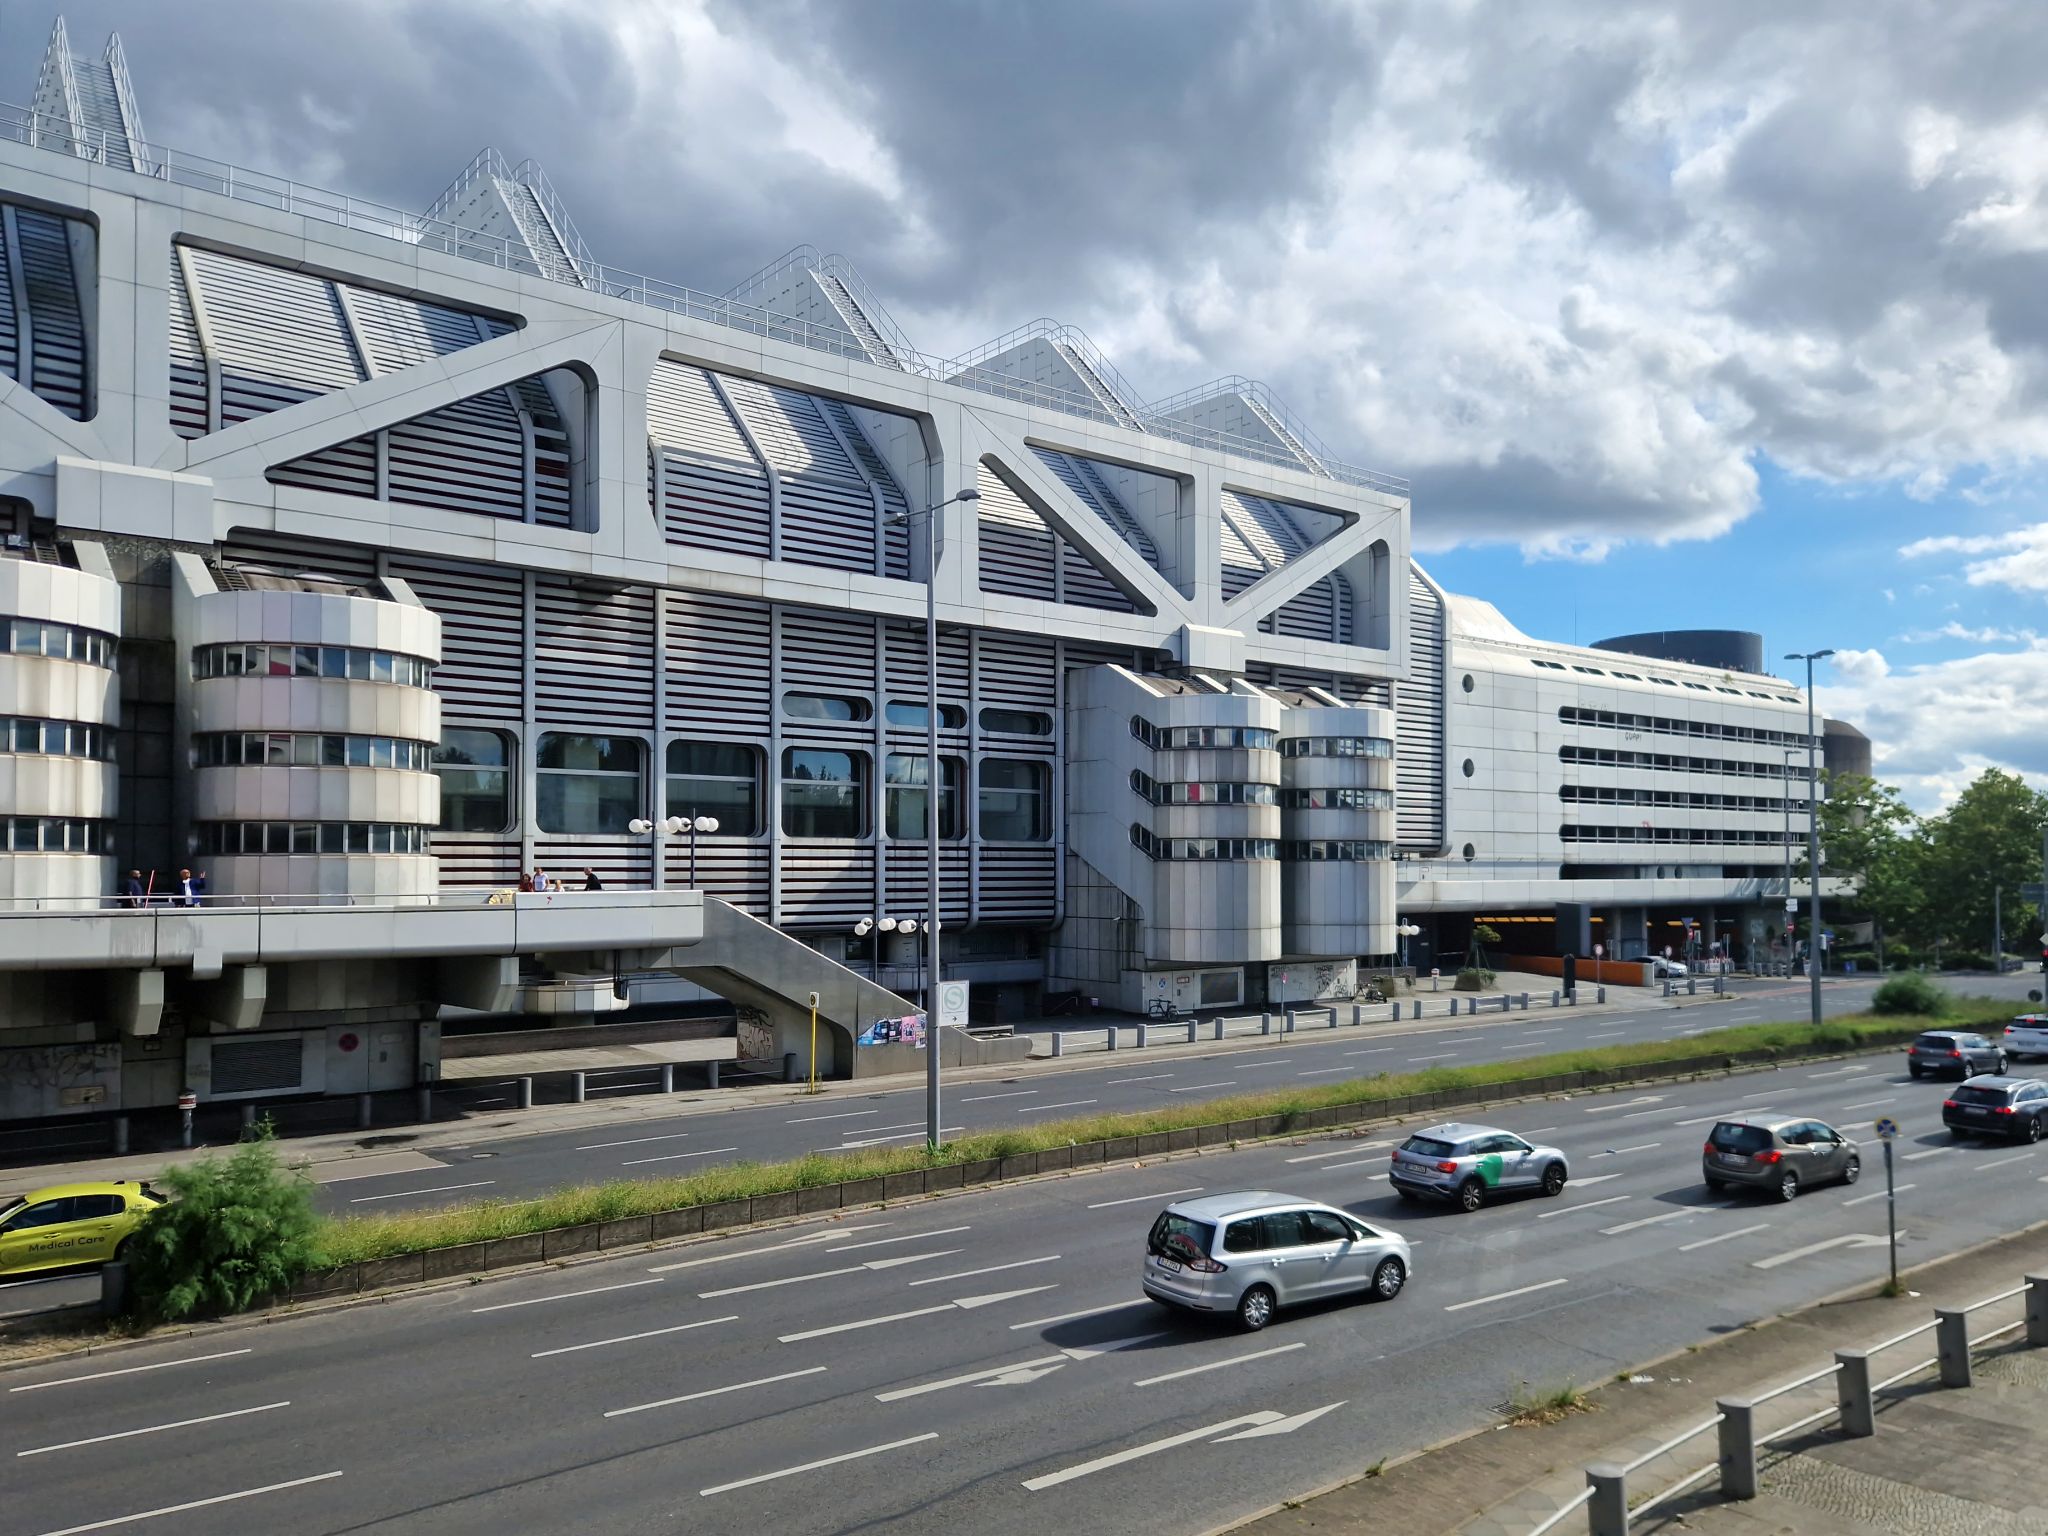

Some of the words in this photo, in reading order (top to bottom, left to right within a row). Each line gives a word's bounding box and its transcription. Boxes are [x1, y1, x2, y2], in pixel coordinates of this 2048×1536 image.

[946, 988, 964, 1008] S
[28, 1239, 74, 1252] Medical
[78, 1236, 105, 1245] Care
